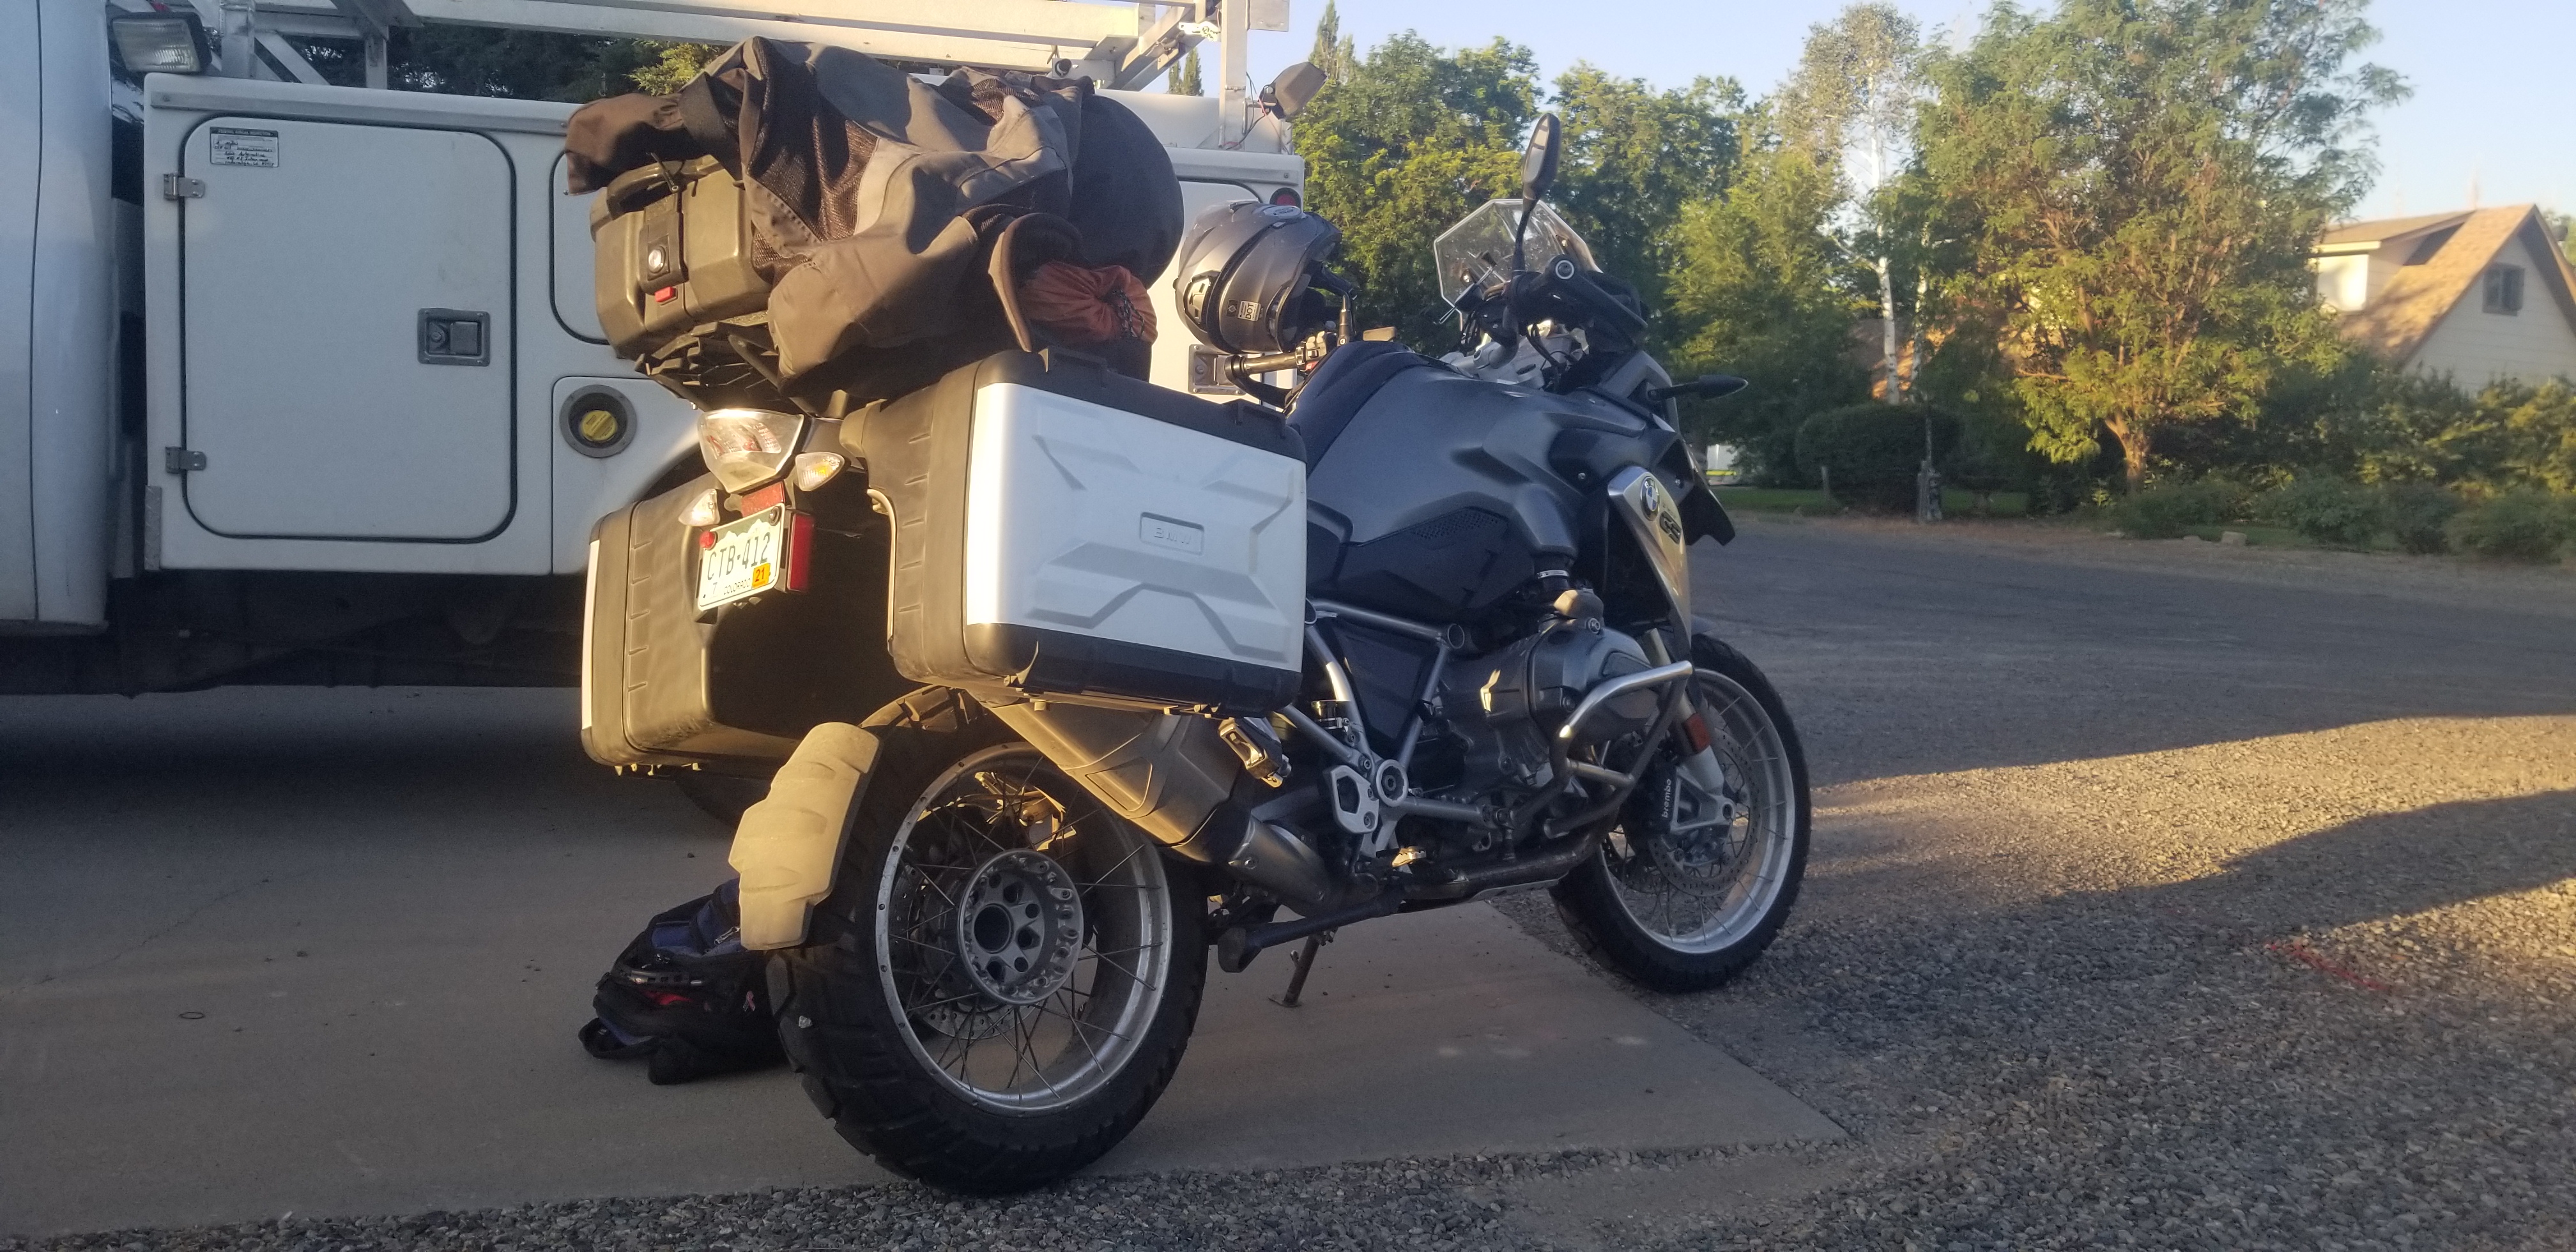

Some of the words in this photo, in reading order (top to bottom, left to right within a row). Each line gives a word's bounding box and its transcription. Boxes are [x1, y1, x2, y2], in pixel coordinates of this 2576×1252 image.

[1245, 302, 1254, 319] DOT
[1660, 510, 1682, 544] GS
[755, 566, 765, 583] 21
[723, 577, 751, 595] COLORADO
[1661, 779, 1671, 818] brembo
